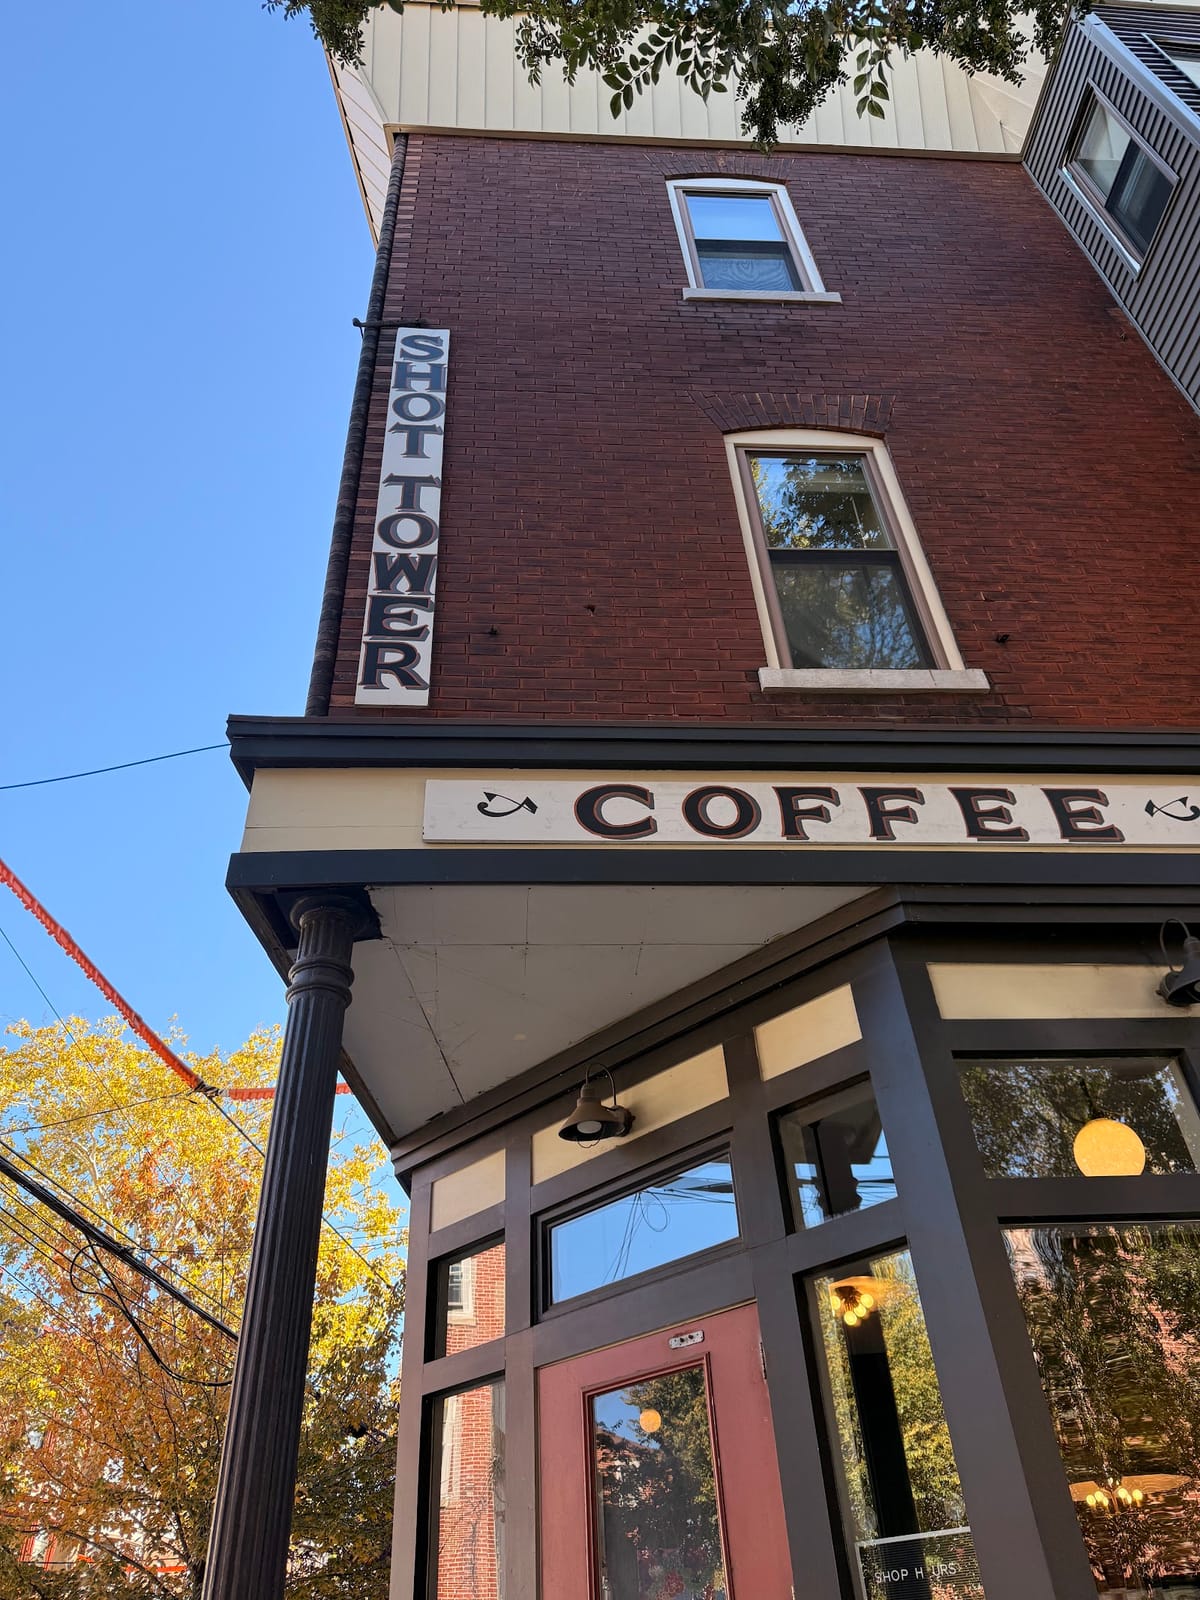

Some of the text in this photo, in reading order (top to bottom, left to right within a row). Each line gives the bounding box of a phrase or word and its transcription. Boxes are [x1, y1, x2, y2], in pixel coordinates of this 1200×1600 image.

[358, 334, 446, 690] SHOT TOWER
[573, 784, 1125, 842] COFFEE
[874, 1562, 957, 1583] SHOP HURS
